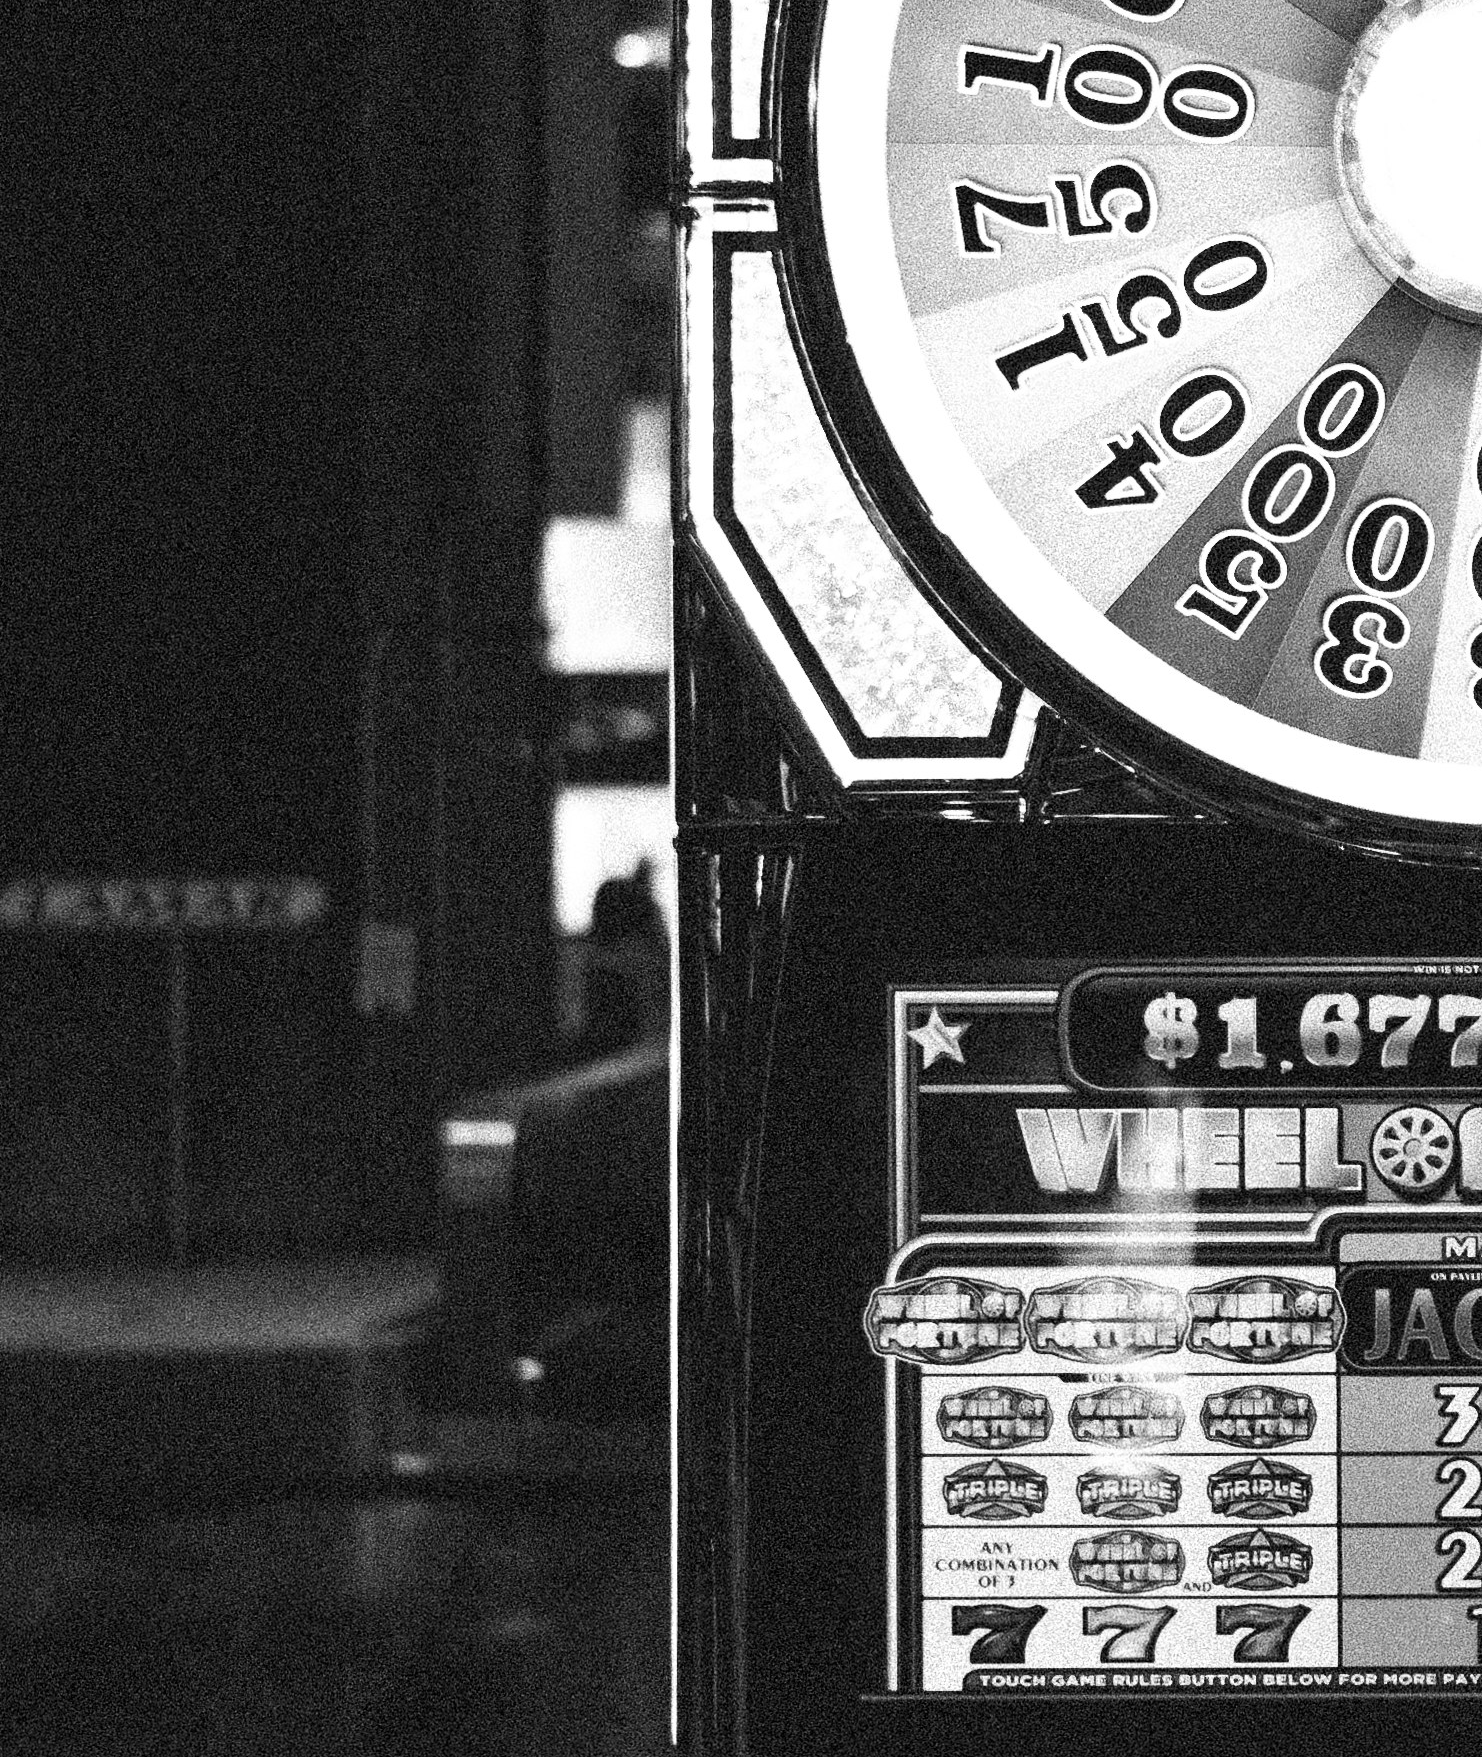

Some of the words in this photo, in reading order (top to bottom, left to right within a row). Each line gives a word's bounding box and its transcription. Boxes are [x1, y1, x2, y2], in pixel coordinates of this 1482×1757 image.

[958, 43, 1255, 143] 100
[953, 160, 1158, 258] 75
[995, 235, 1273, 392] 150
[1074, 369, 1251, 509] 40
[1174, 363, 1386, 640] 500
[1314, 497, 1435, 699] 30
[953, 1479, 1041, 1500] TRIPLE
[1086, 1479, 1174, 1500] TRIPLE
[1219, 1479, 1306, 1500] TRIPLE
[935, 1559, 1059, 1572] COMBINATION
[980, 1542, 1013, 1555] ANY
[1219, 1552, 1306, 1573] TRIPLE
[1183, 1581, 1212, 1592] AND
[951, 1605, 1048, 1663] 7
[1082, 1605, 1178, 1663] 7
[1215, 1605, 1312, 1663] 7
[980, 1673, 1046, 1687] TOUCH
[1052, 1673, 1107, 1687] GAME
[1113, 1673, 1173, 1687] RULES
[1179, 1673, 1257, 1687] BUTTON
[1262, 1673, 1331, 1687] BELOW
[1338, 1673, 1376, 1687] FOR
[1384, 1673, 1438, 1687] MORE
